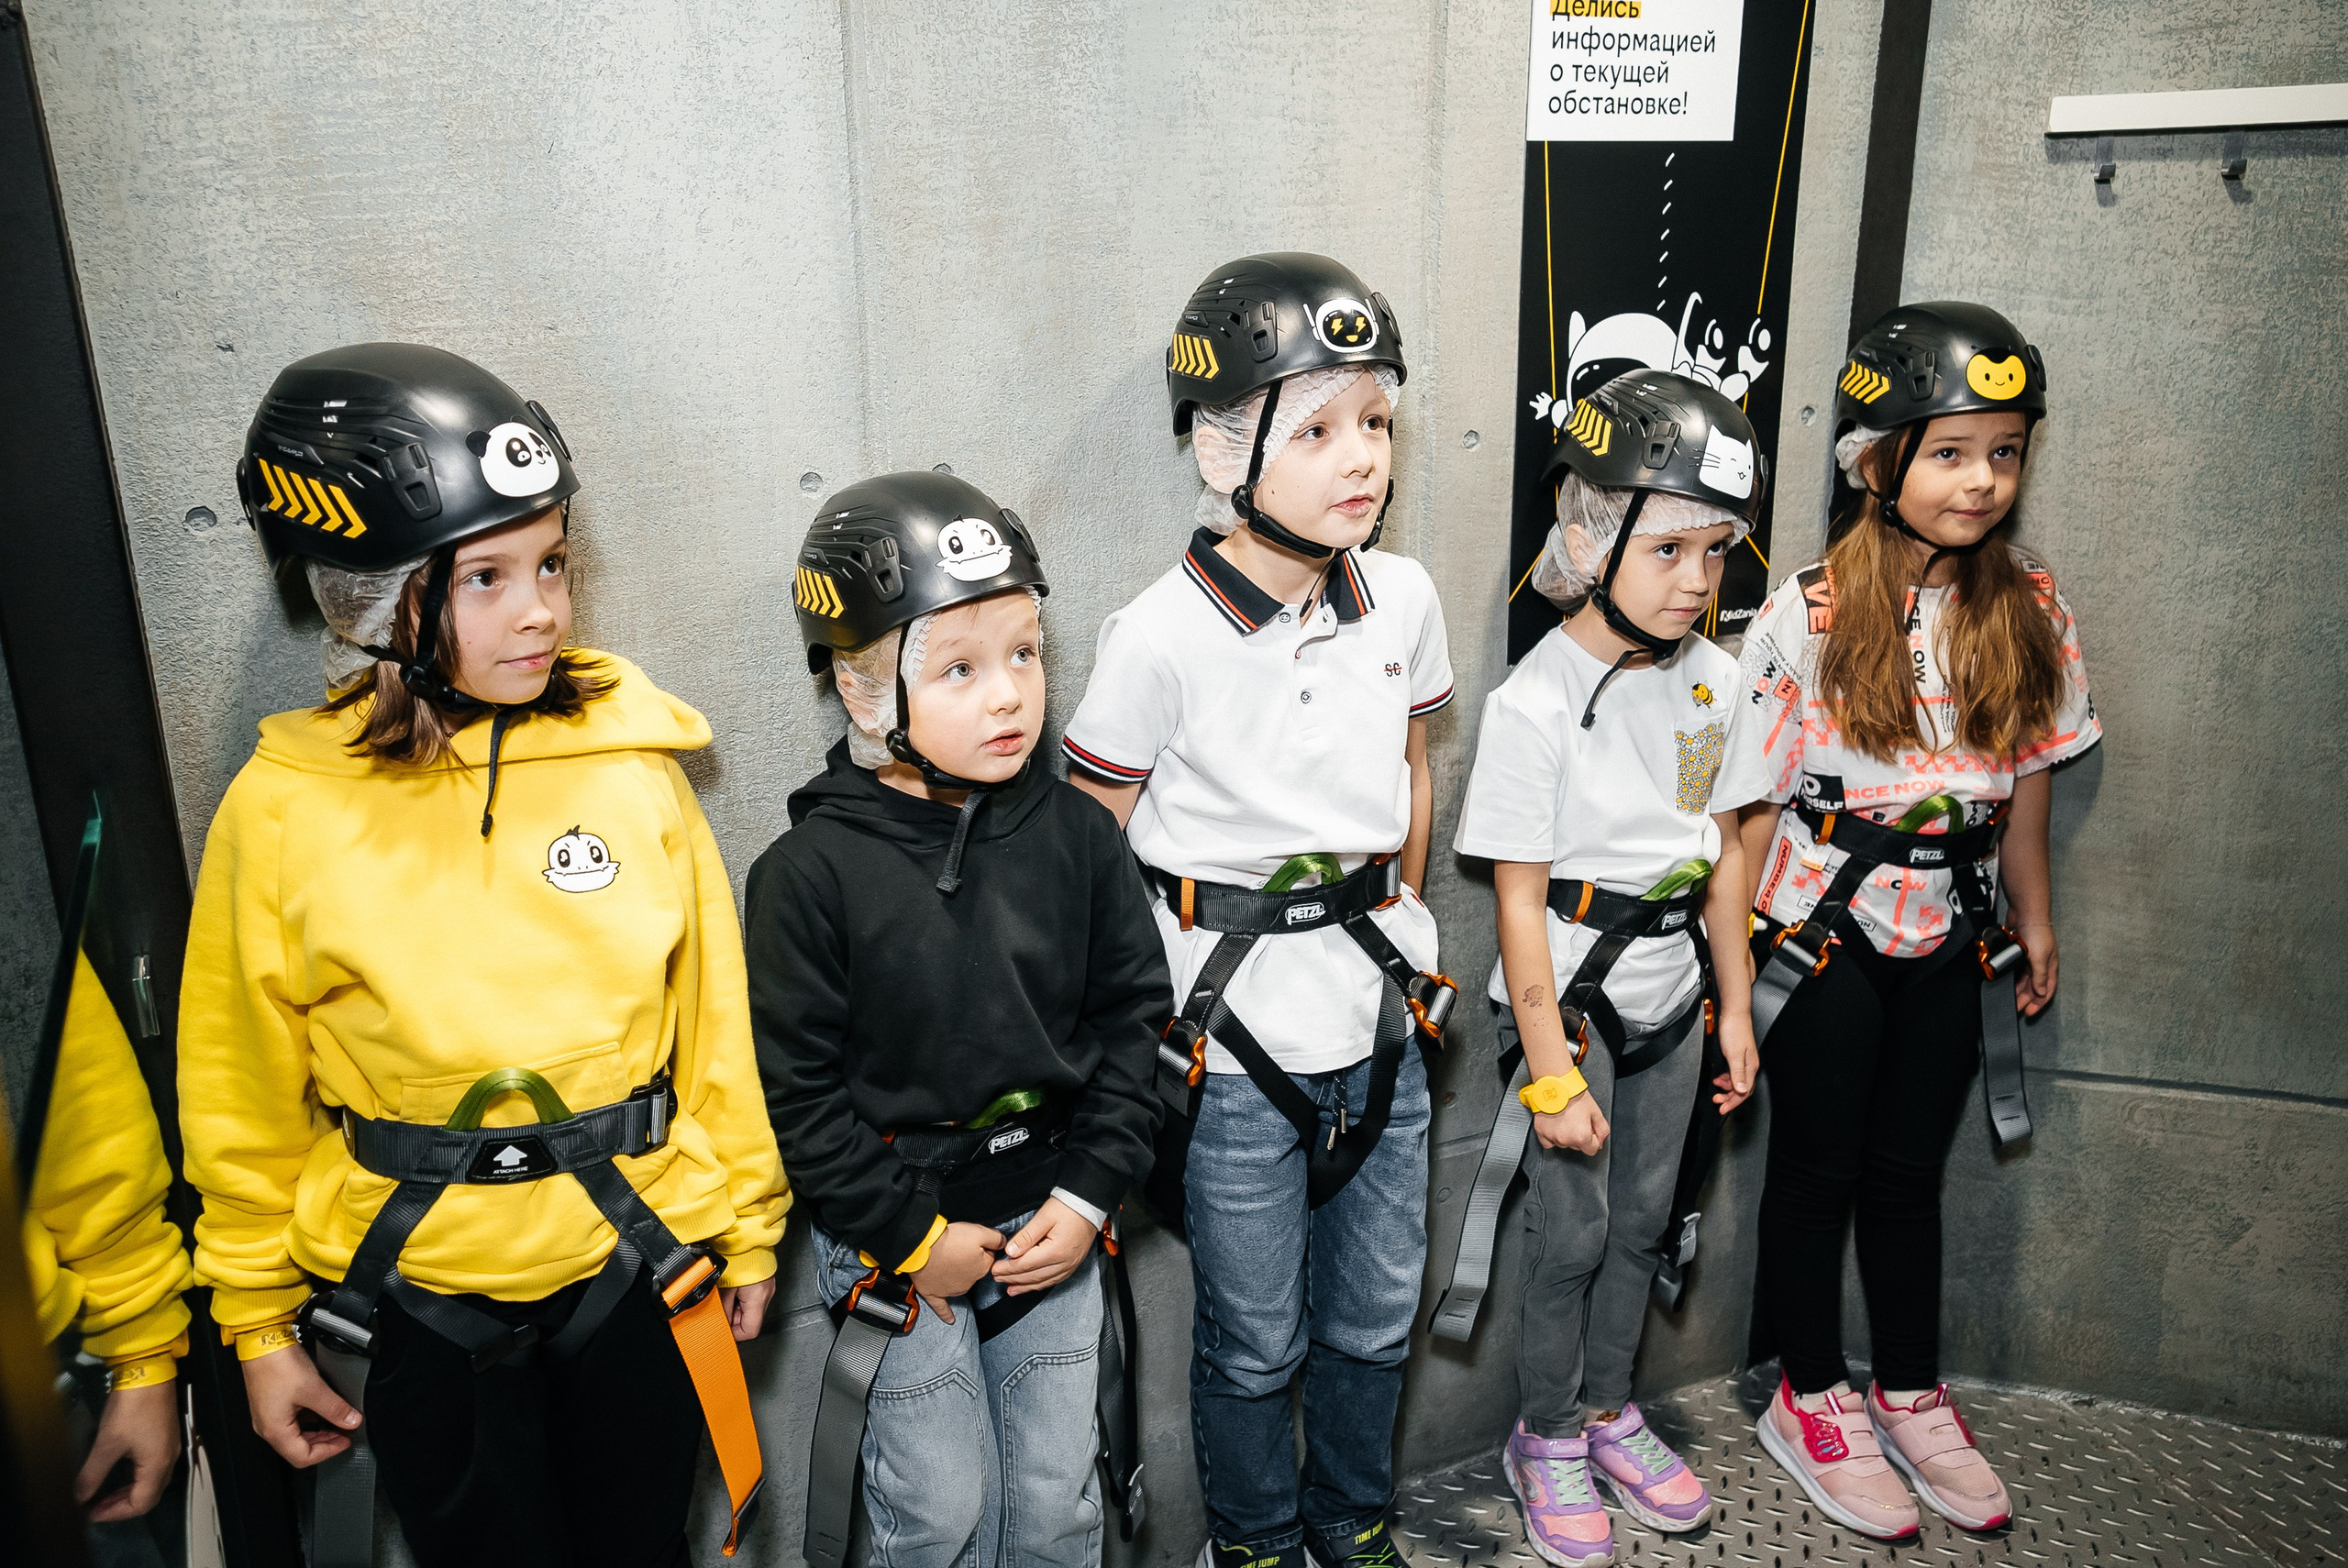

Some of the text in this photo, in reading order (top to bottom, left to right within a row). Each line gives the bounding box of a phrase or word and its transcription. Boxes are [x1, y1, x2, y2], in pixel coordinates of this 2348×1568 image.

[1552, 0, 1640, 21] Делись
[1552, 26, 1716, 57] информацией
[1550, 61, 1669, 89] о текущей
[1548, 90, 1688, 115] обстановке!
[1910, 634, 1926, 684] NOW
[1751, 660, 1777, 705] NOW
[1894, 779, 1945, 795] NOW
[1910, 848, 1944, 864] PETZL
[1764, 844, 1789, 899] NUMBER
[1287, 904, 1326, 926] PETZL
[991, 1130, 1030, 1154] PETZL
[1354, 1529, 1371, 1545] TIME
[1257, 1556, 1280, 1568] JUMP
